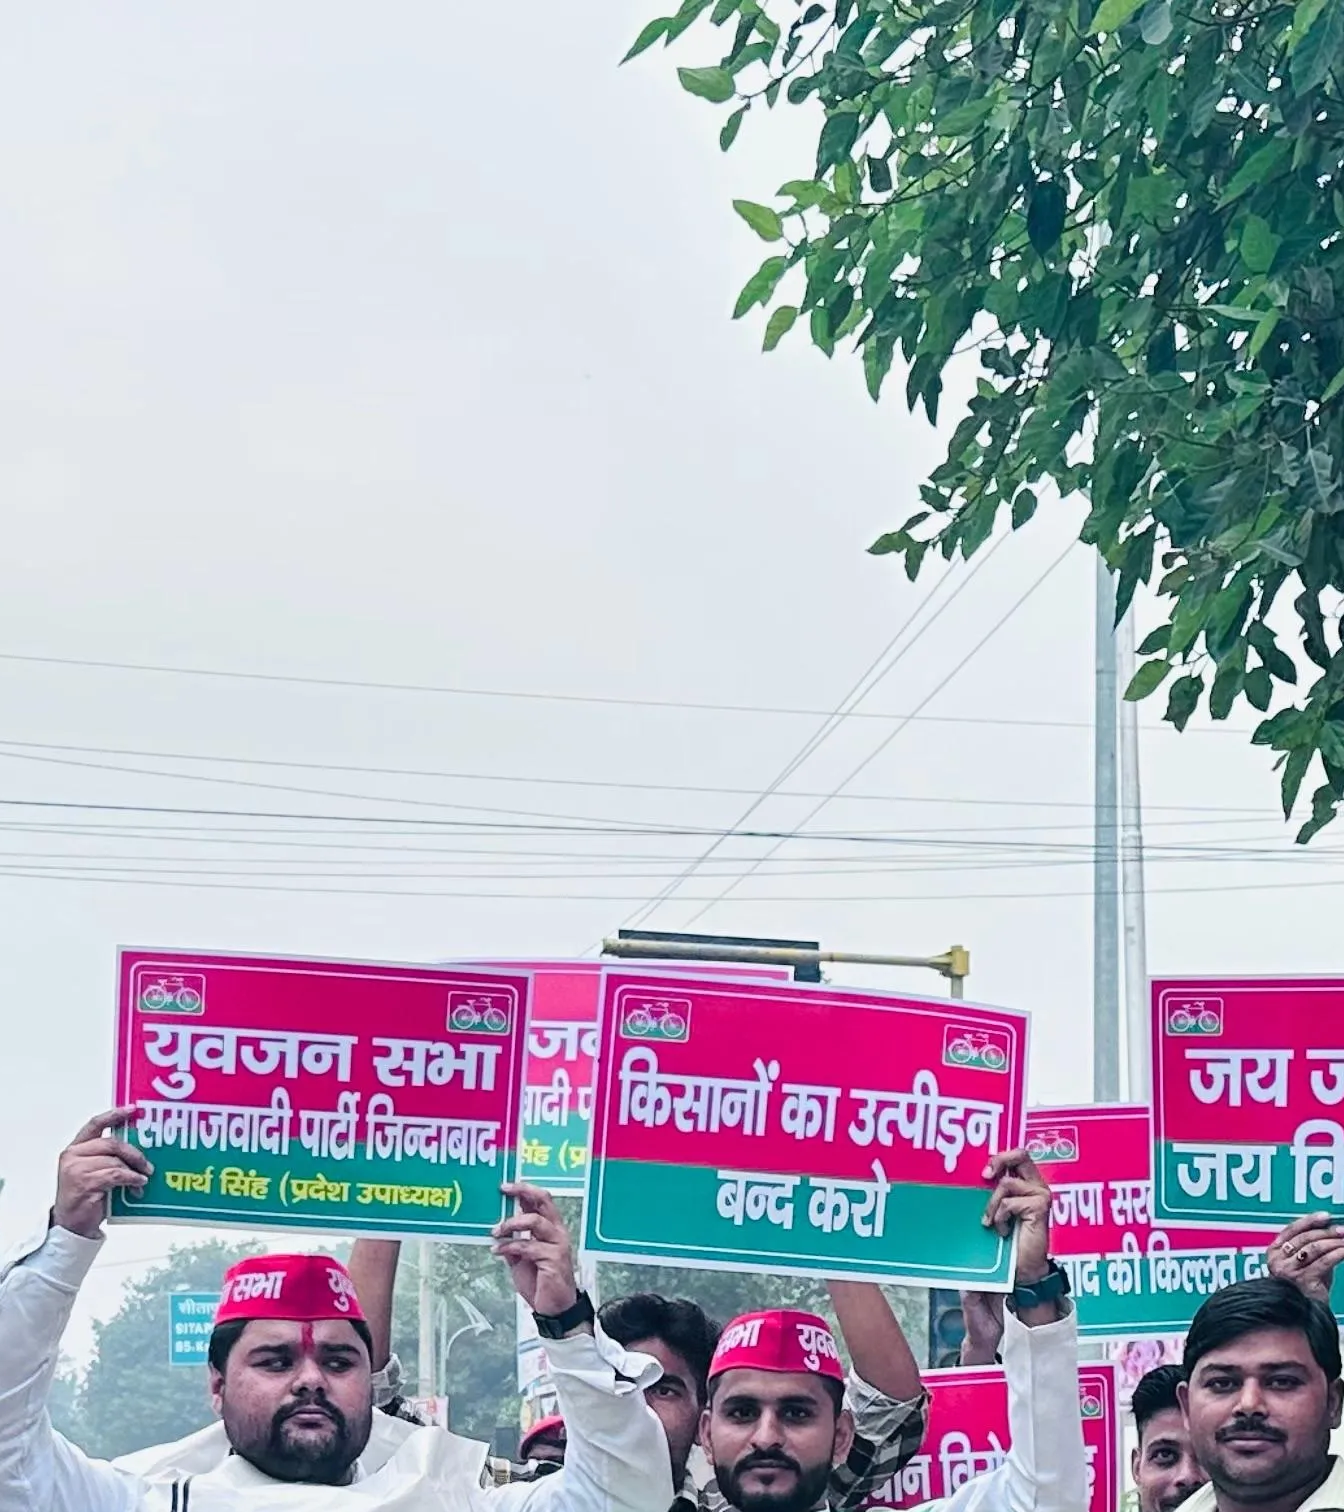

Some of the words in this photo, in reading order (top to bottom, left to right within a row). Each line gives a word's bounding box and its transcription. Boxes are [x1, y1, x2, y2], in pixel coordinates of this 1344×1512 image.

[141, 1022, 359, 1099] युवजन
[371, 1036, 503, 1092] सभा
[1184, 1047, 1295, 1109] जय
[134, 1086, 293, 1156] समाजवादी
[298, 1090, 361, 1161] पार्टी
[365, 1093, 501, 1168] जिन्दाबाद
[618, 1045, 781, 1138] किसानों
[780, 1081, 841, 1143] का
[164, 1167, 215, 1195] पार्थ
[219, 1165, 272, 1200] सिंह
[278, 1170, 351, 1209] (प्रदेश
[356, 1179, 464, 1216] उपाध्यक्ष)
[715, 1169, 803, 1231] बन्द
[806, 1157, 892, 1239] करो
[1171, 1143, 1278, 1204] जय
[232, 1270, 288, 1303] सभा
[1103, 1230, 1142, 1296] की
[1146, 1230, 1238, 1295] किल्लत
